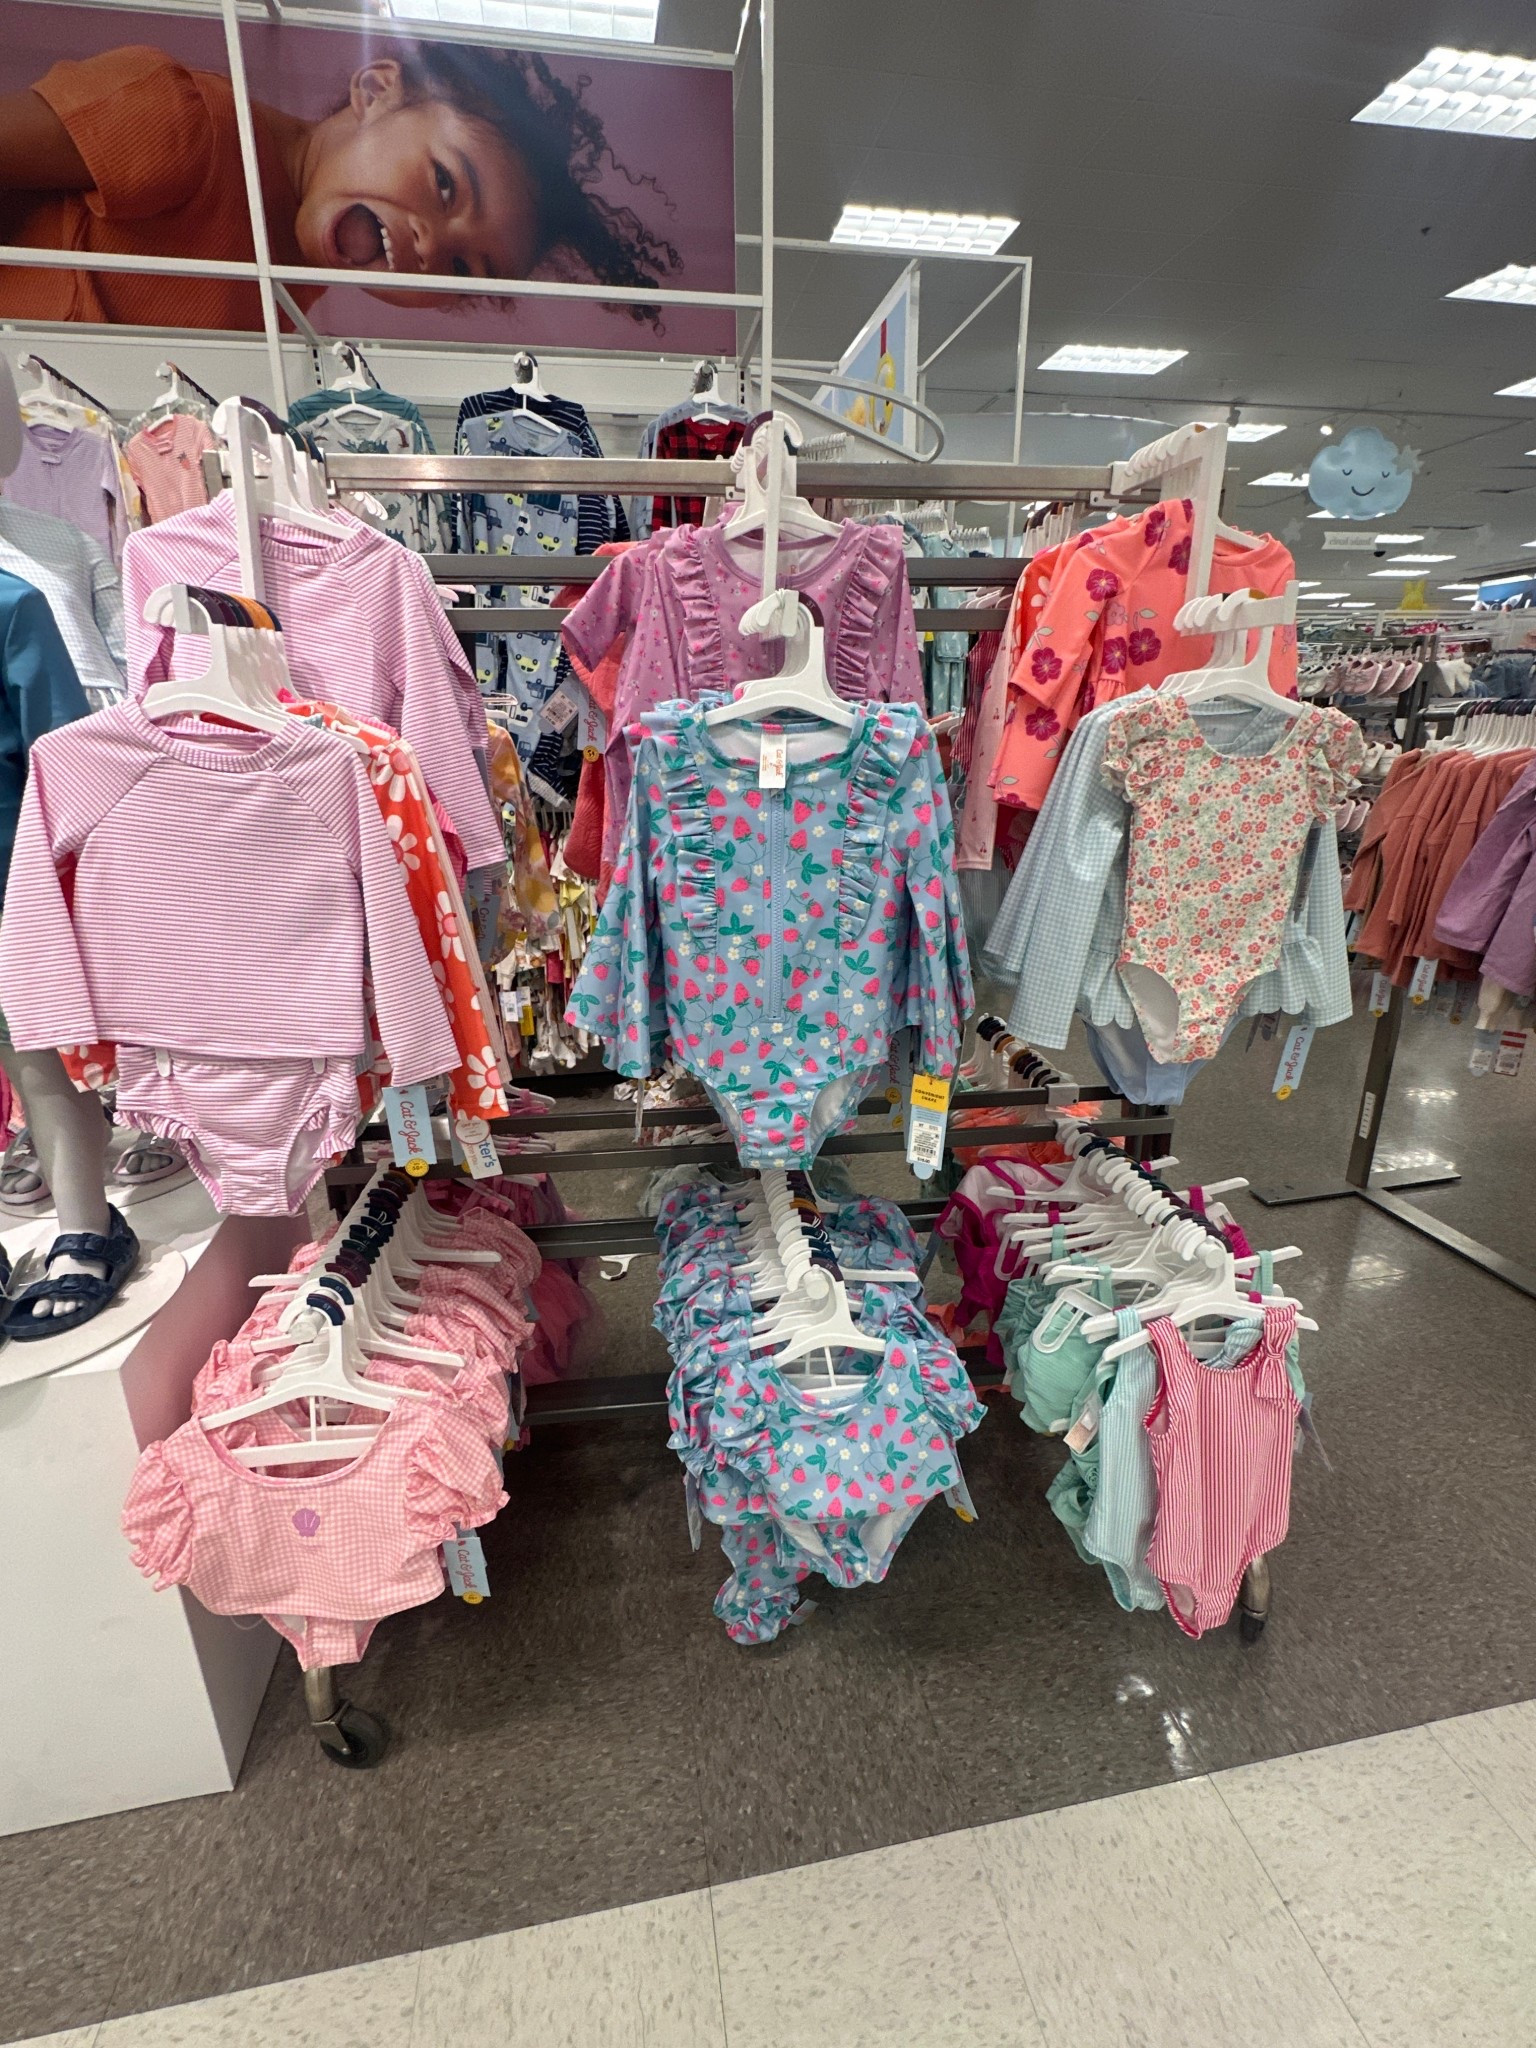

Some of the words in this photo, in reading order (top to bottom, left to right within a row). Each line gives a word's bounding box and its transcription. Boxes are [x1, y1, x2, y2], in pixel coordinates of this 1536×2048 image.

[400, 1101, 414, 1119] Cat
[404, 1120, 417, 1130] &
[398, 1128, 423, 1155] Jack
[479, 1141, 497, 1168] ter's
[458, 1549, 469, 1562] Cat
[456, 1570, 477, 1588] Jack
